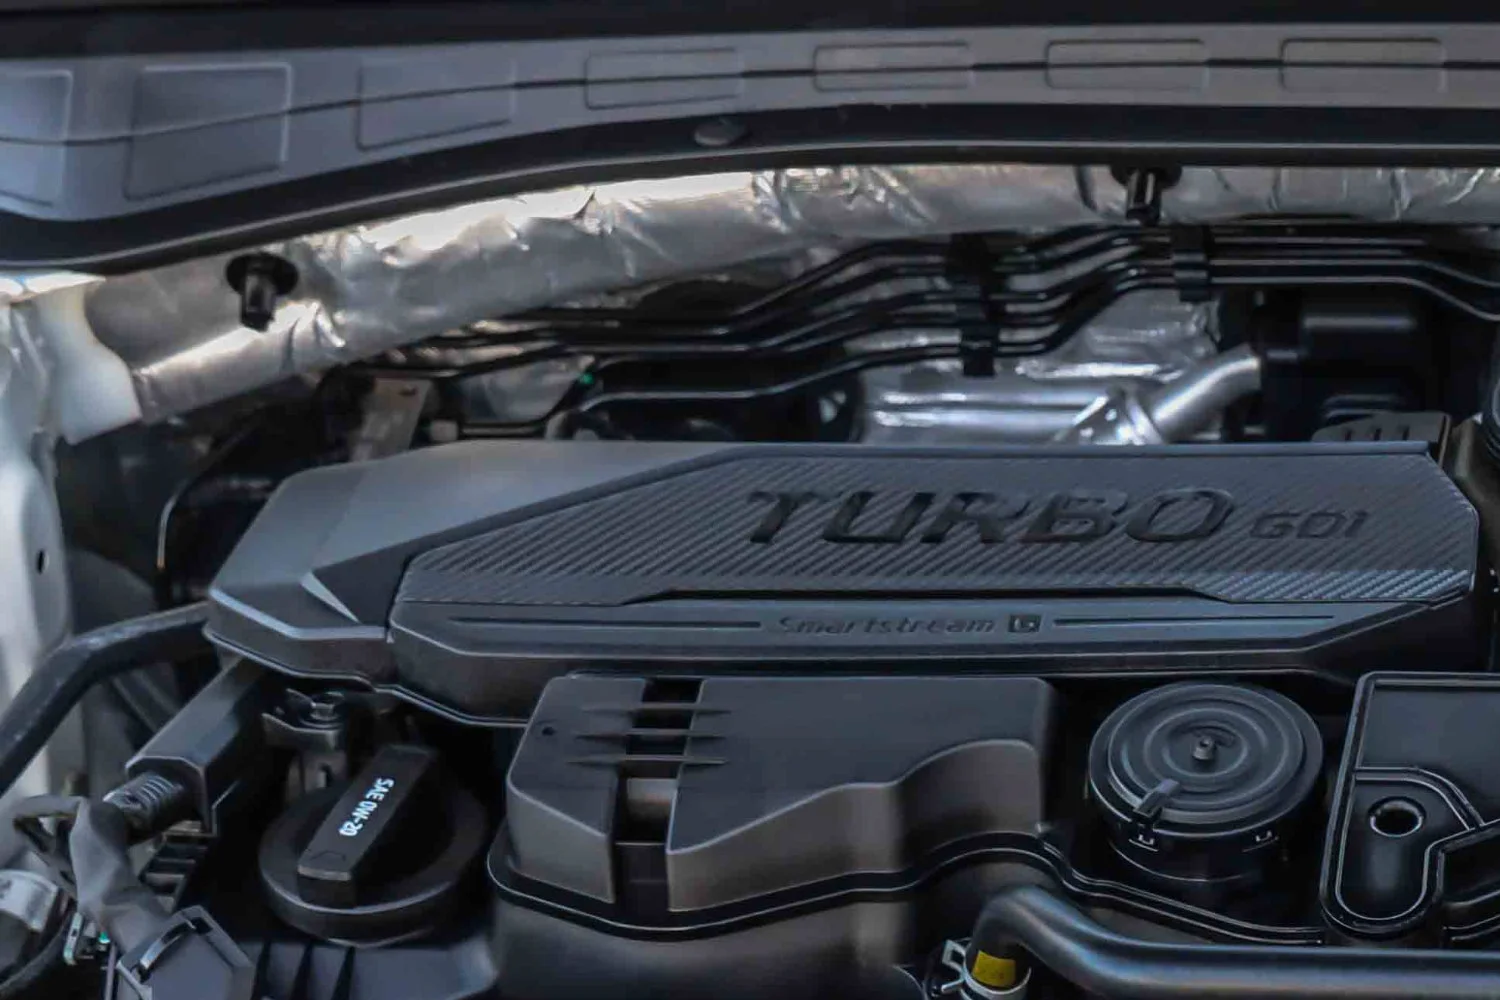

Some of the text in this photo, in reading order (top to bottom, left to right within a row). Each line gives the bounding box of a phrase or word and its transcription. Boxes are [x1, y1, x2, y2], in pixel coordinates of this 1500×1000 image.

[748, 488, 1235, 544] TURBO
[778, 616, 993, 636] Smartstream
[339, 778, 394, 836] SAE 0W-20
